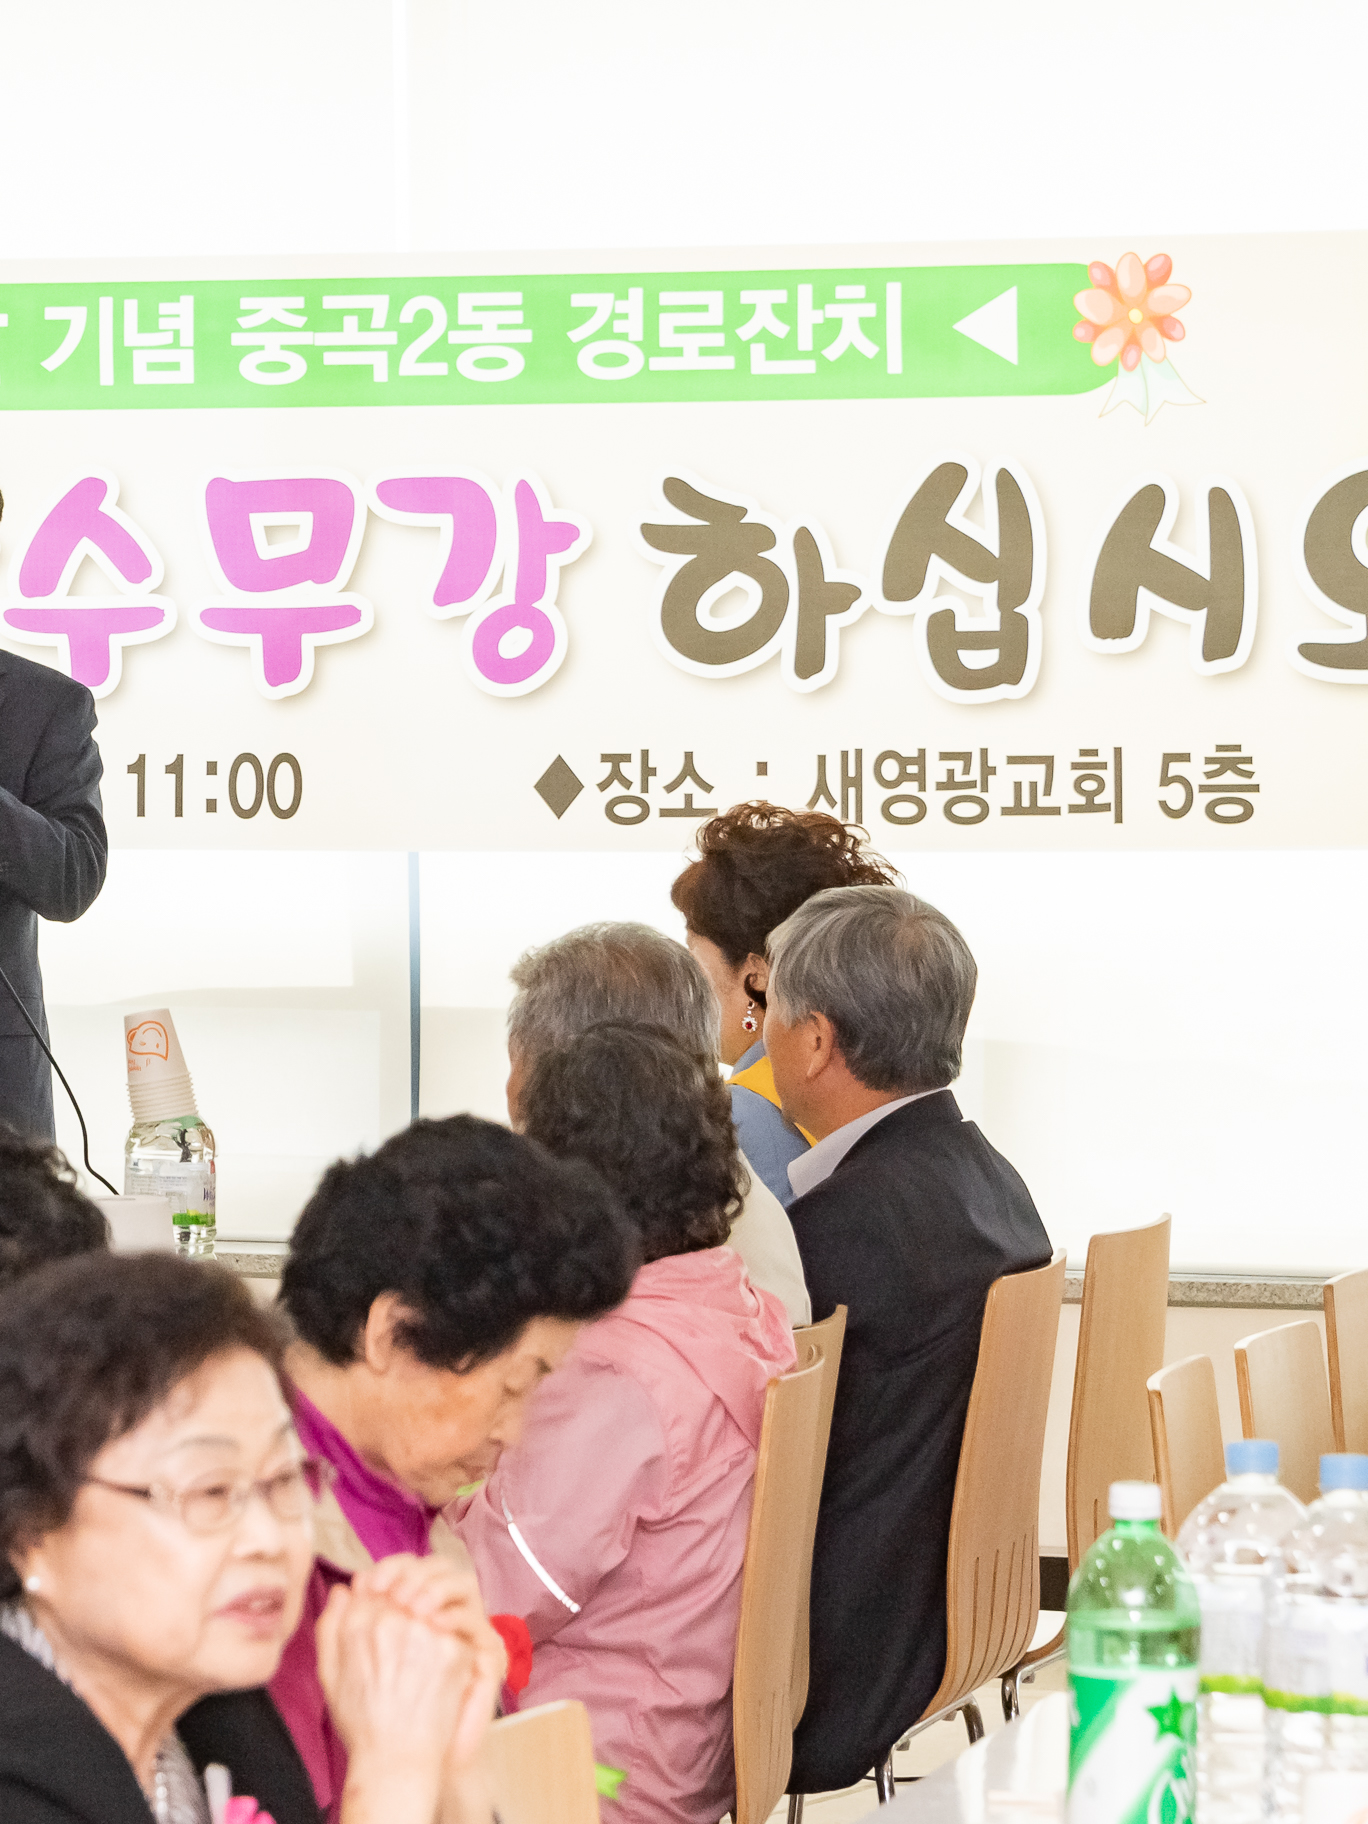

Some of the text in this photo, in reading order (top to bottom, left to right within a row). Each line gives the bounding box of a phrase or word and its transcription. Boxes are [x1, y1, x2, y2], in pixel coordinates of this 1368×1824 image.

[39, 295, 195, 386] 기념
[230, 291, 533, 385] 중곡2동
[566, 281, 903, 381] 경로잔치
[126, 752, 303, 820] 11:00
[595, 748, 719, 826] 장소
[805, 746, 1124, 826] 새영광교회
[1157, 744, 1261, 825] 5층
